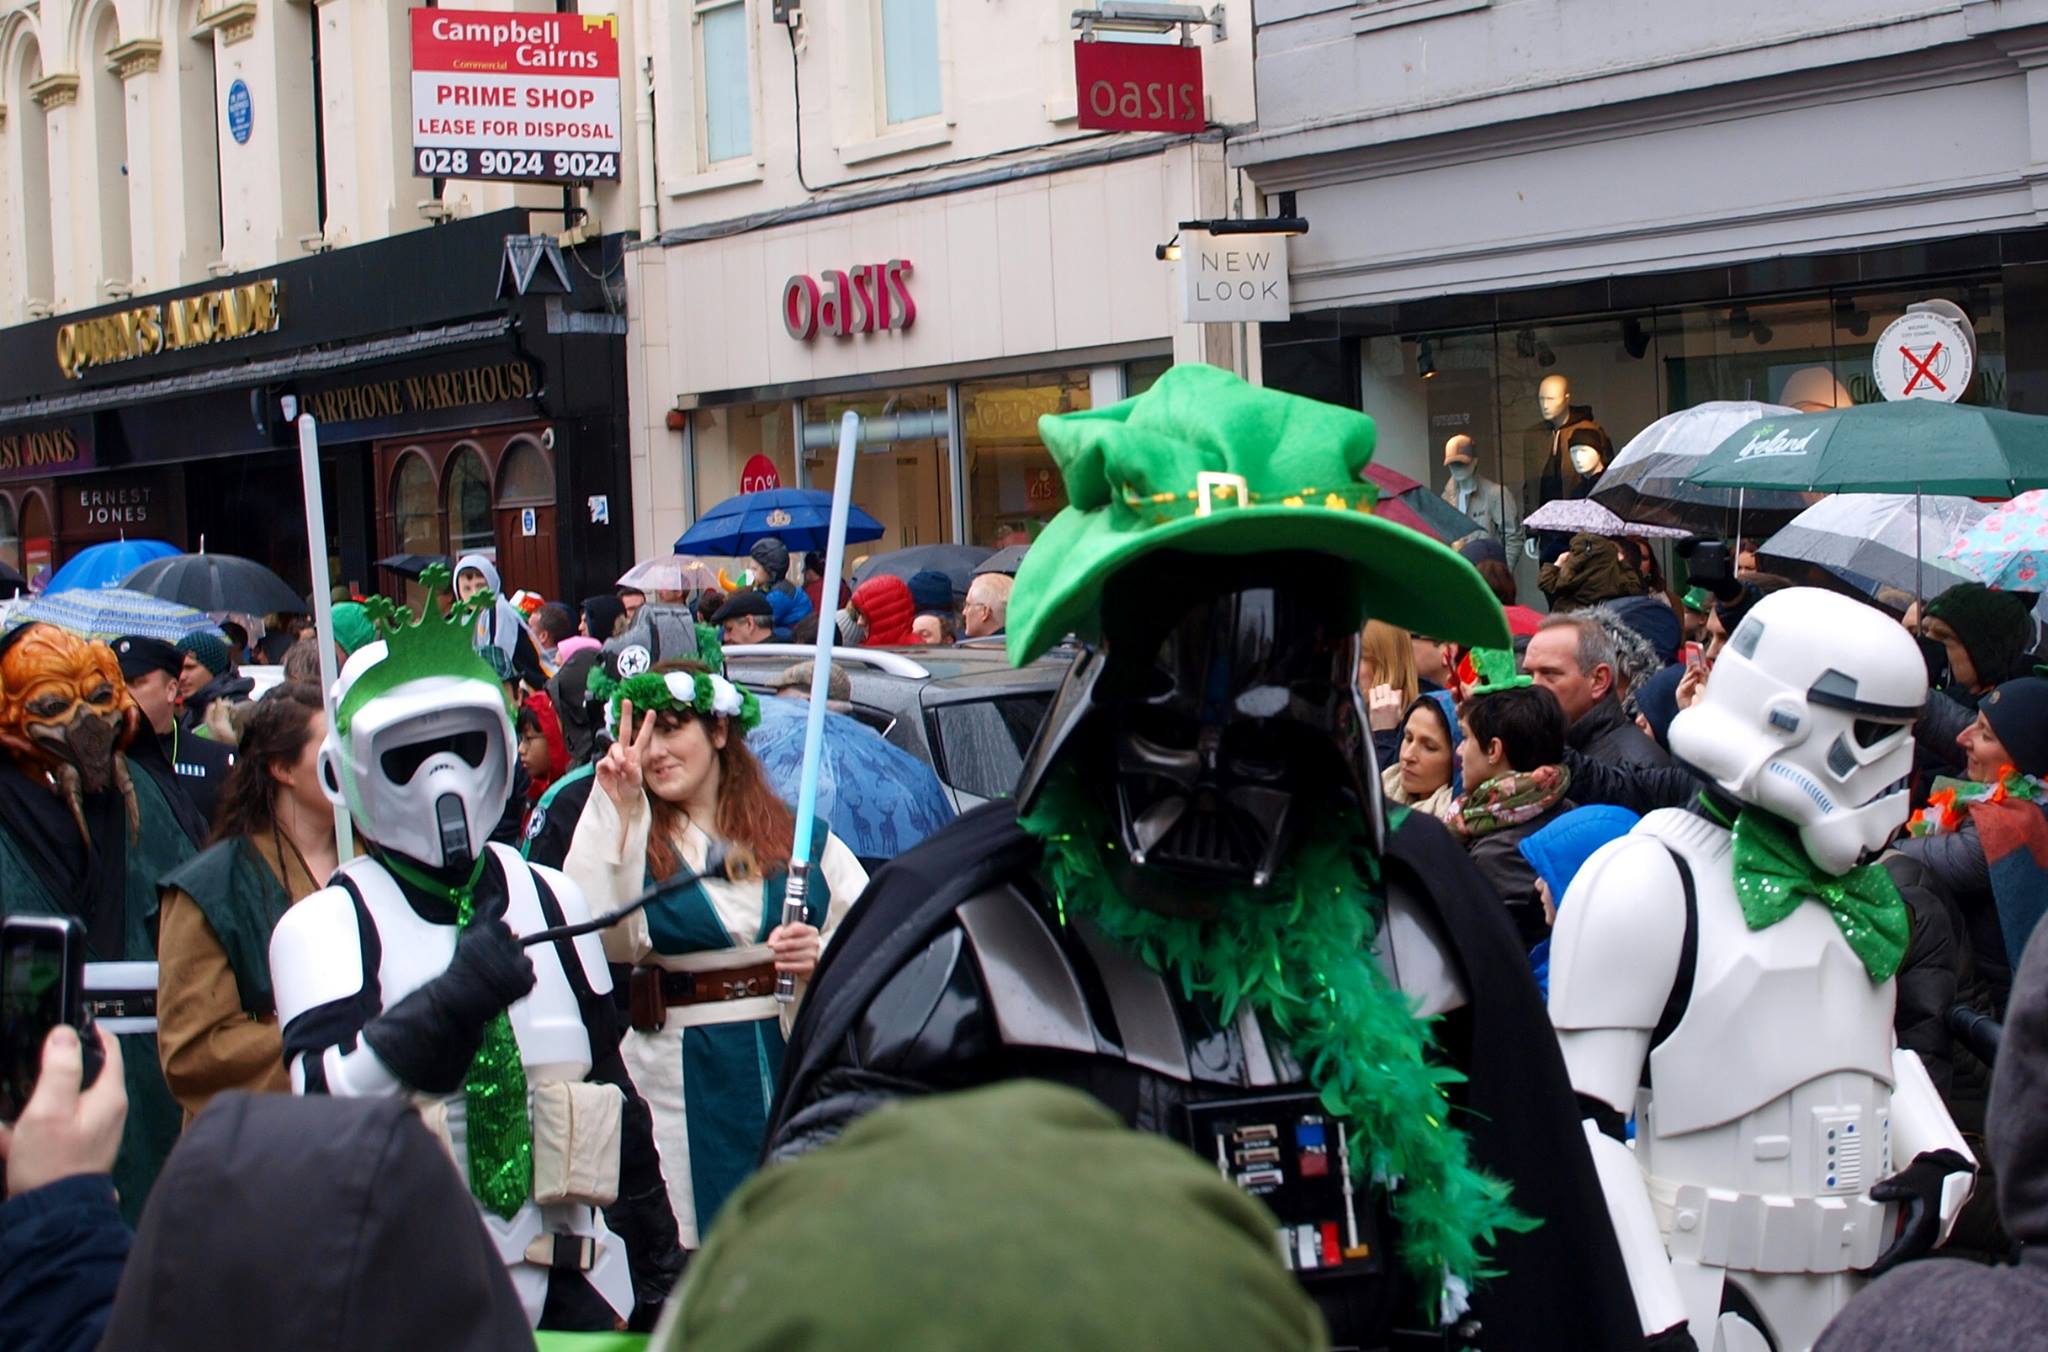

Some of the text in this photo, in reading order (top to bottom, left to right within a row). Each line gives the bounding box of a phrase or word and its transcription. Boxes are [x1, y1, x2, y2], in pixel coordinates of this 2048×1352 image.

[432, 18, 560, 47] Campbell
[452, 59, 508, 71] Commercial
[515, 44, 599, 69] Cairns
[437, 85, 595, 109] PRIME SHOP
[419, 118, 614, 139] LEASE FOR DISPOSAL
[419, 149, 616, 177] 028 9024 9024
[1202, 251, 1270, 271] NEW
[1196, 280, 1279, 301] LOOK
[164, 277, 280, 351] ARCADE
[302, 379, 403, 425] CARPHONE
[26, 428, 76, 466] JONES
[80, 488, 151, 507] ERNEST
[88, 506, 148, 524] JONES
